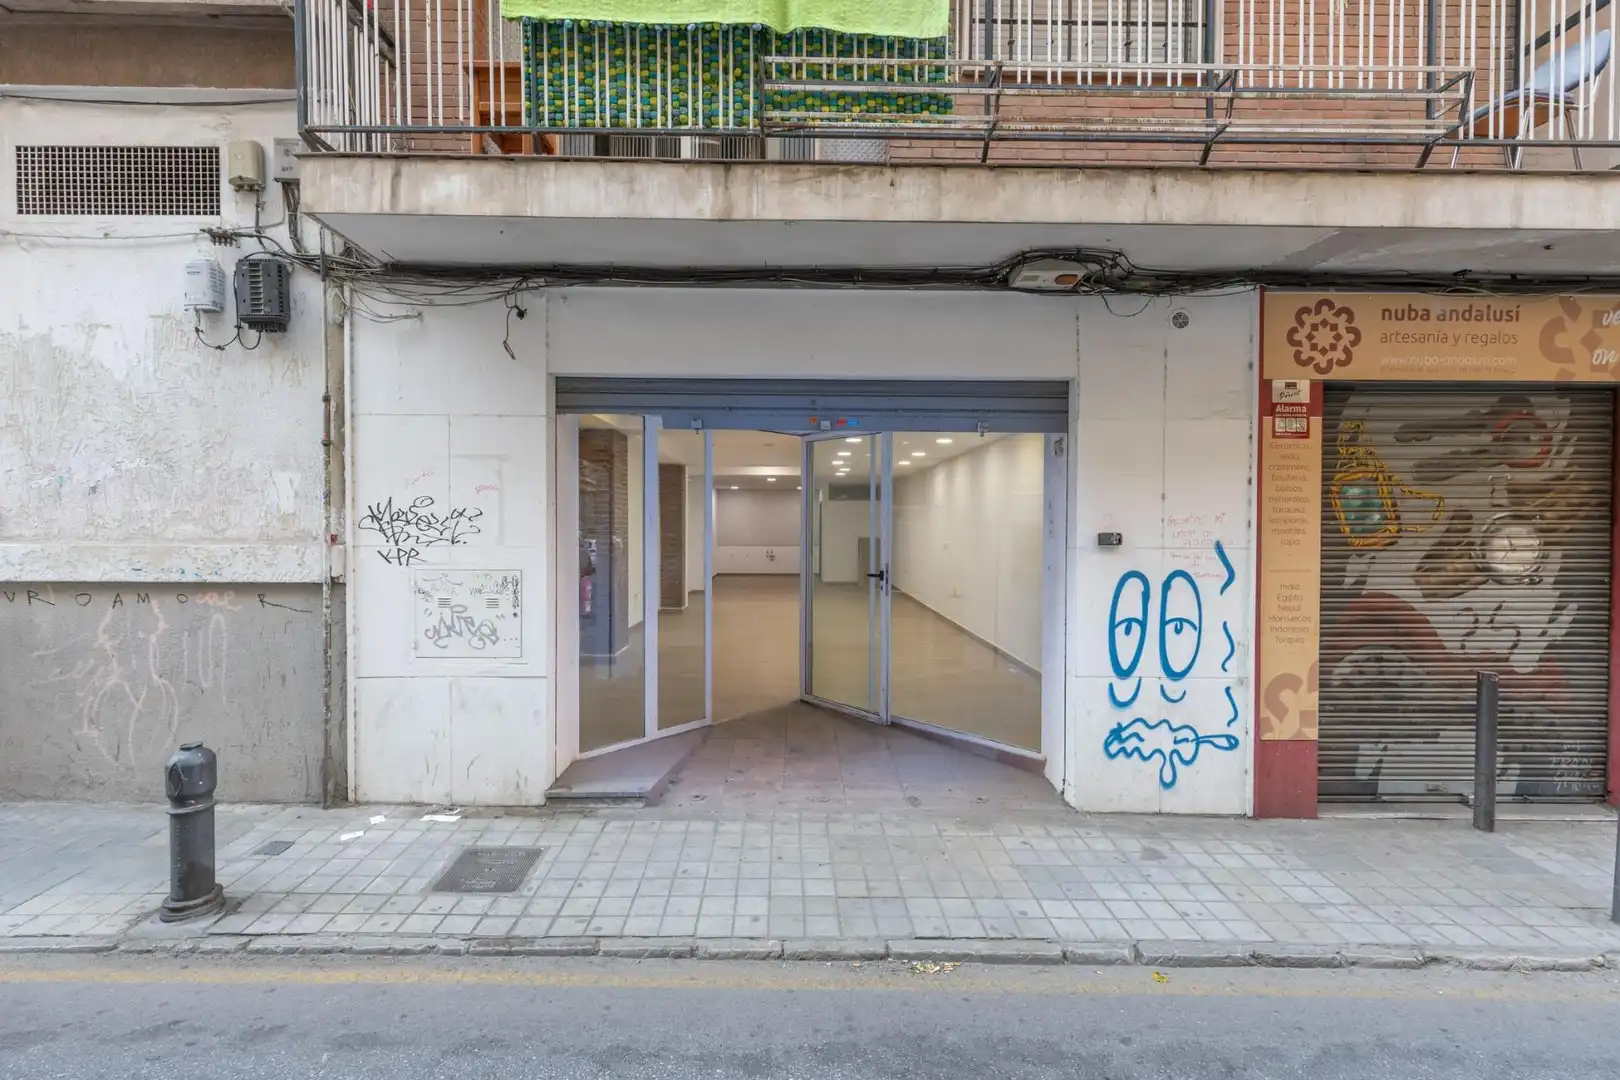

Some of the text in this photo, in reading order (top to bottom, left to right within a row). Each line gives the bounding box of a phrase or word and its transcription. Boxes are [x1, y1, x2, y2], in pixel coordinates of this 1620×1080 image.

[1381, 303, 1521, 322] nuba andalusí
[1380, 329, 1518, 347] artesanía y regalos
[1275, 404, 1307, 413] Alarma
[1280, 539, 1300, 547] ropa
[1279, 583, 1300, 591] India
[1276, 593, 1303, 603] Egipto
[1277, 604, 1302, 613] Nepal
[1269, 626, 1310, 634] Indonesia
